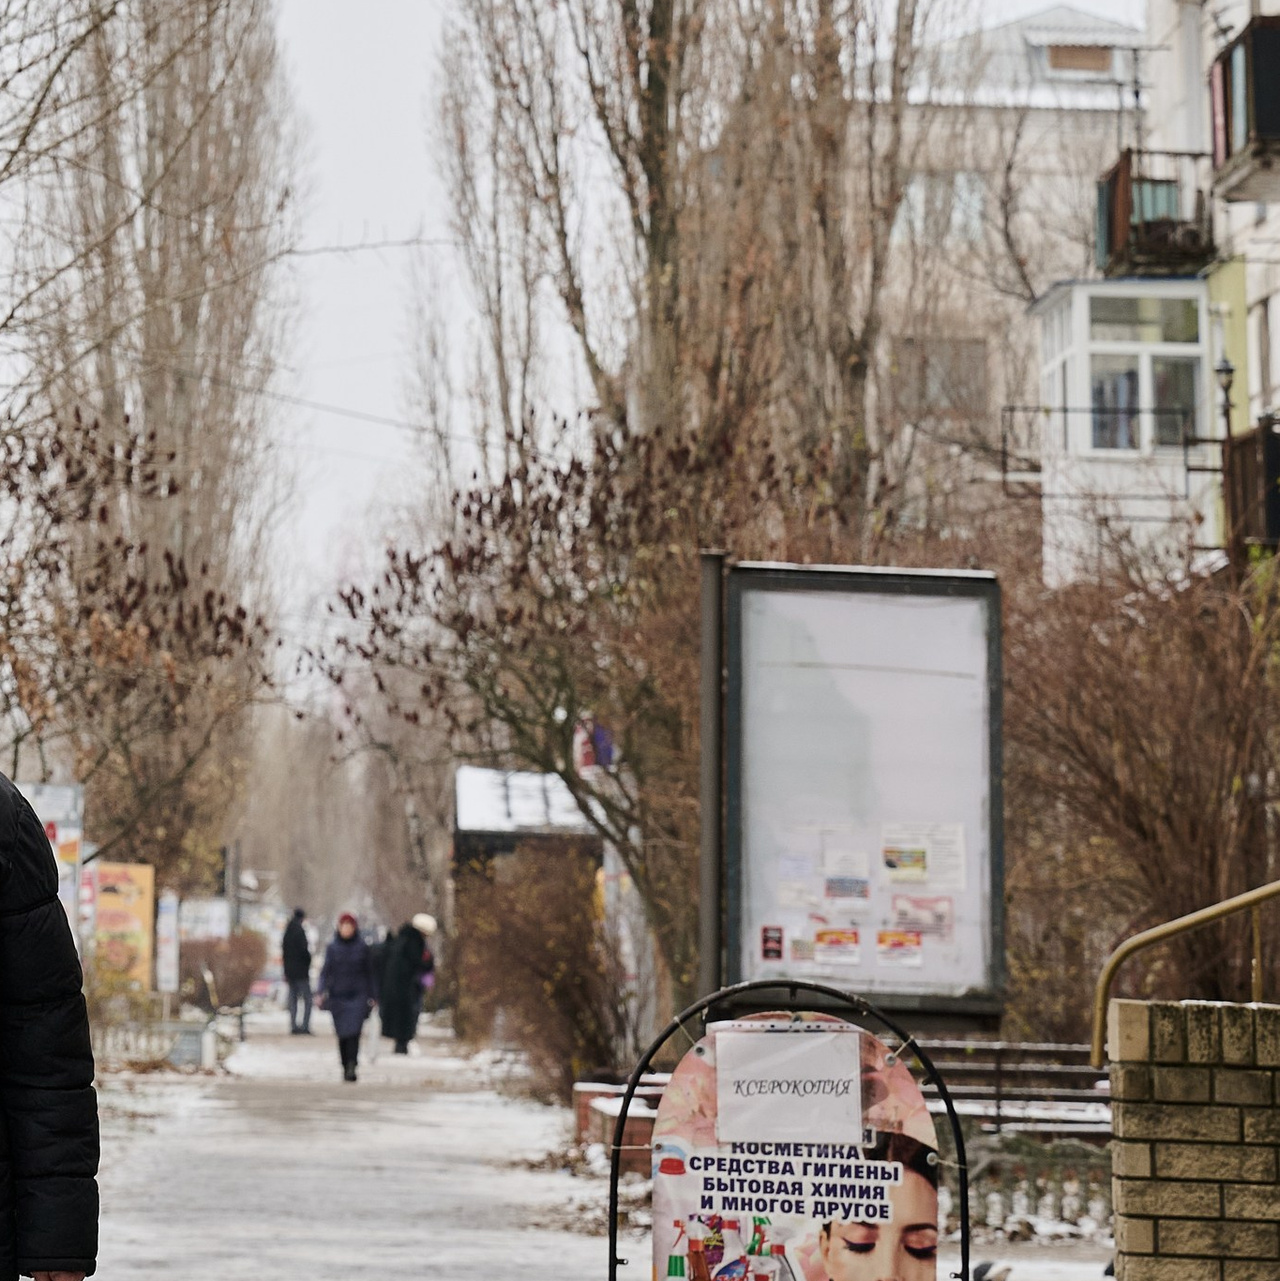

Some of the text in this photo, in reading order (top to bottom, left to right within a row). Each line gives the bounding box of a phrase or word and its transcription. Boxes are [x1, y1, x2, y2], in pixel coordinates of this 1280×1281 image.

[733, 1078, 854, 1098] КСЕРОКОПИЯ
[731, 1142, 860, 1160] КОСМЕТИКА
[689, 1156, 899, 1181] СРЕДСТВА ГИГИЕНЫ
[703, 1177, 885, 1200] БЫТОВАЯ ХИМИЯ
[701, 1195, 890, 1219] И МНОГОЕ ДРУГОЕ
